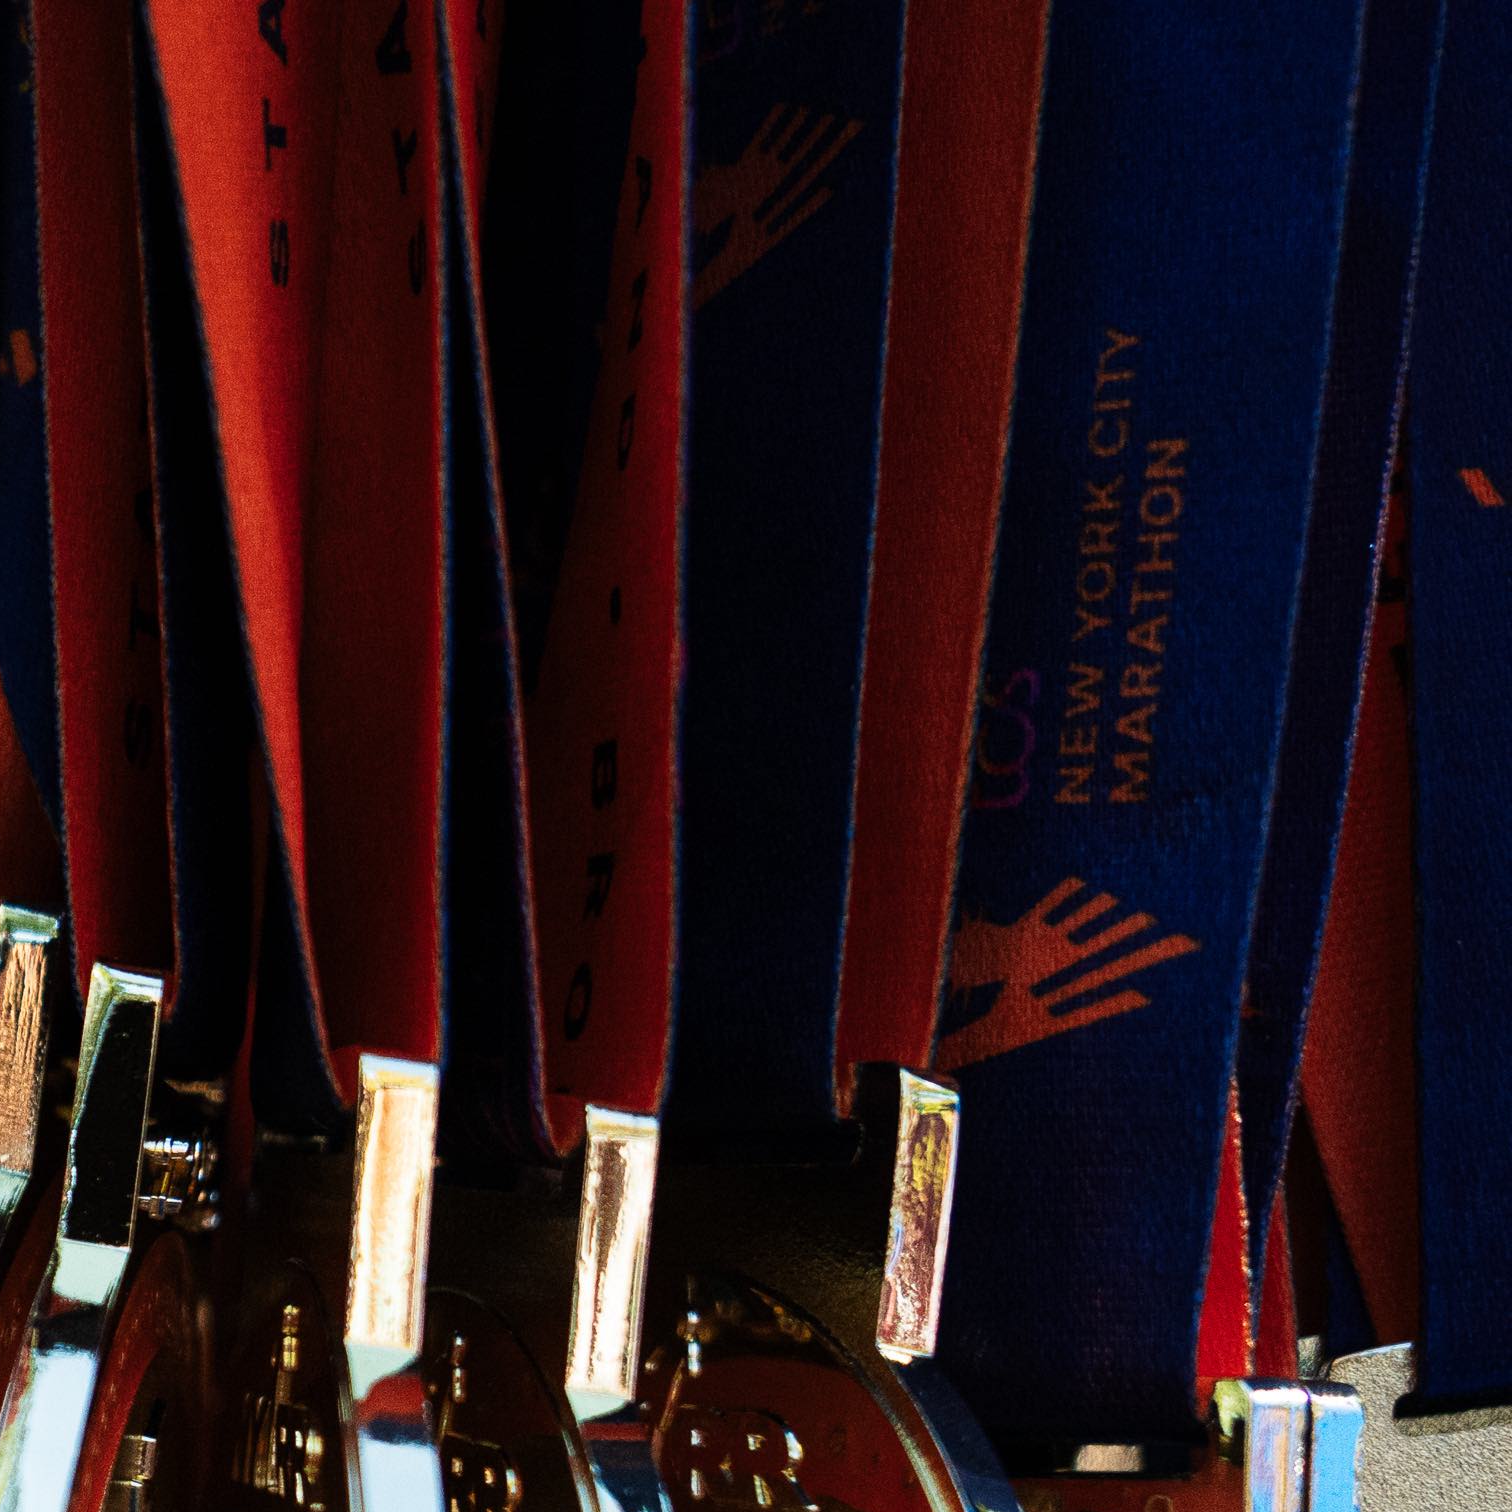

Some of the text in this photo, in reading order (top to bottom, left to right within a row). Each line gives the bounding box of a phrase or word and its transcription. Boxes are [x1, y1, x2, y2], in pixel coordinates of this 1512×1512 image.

[1053, 326, 1141, 805] NEW YORK CITY
[1108, 435, 1190, 804] MARATHON
